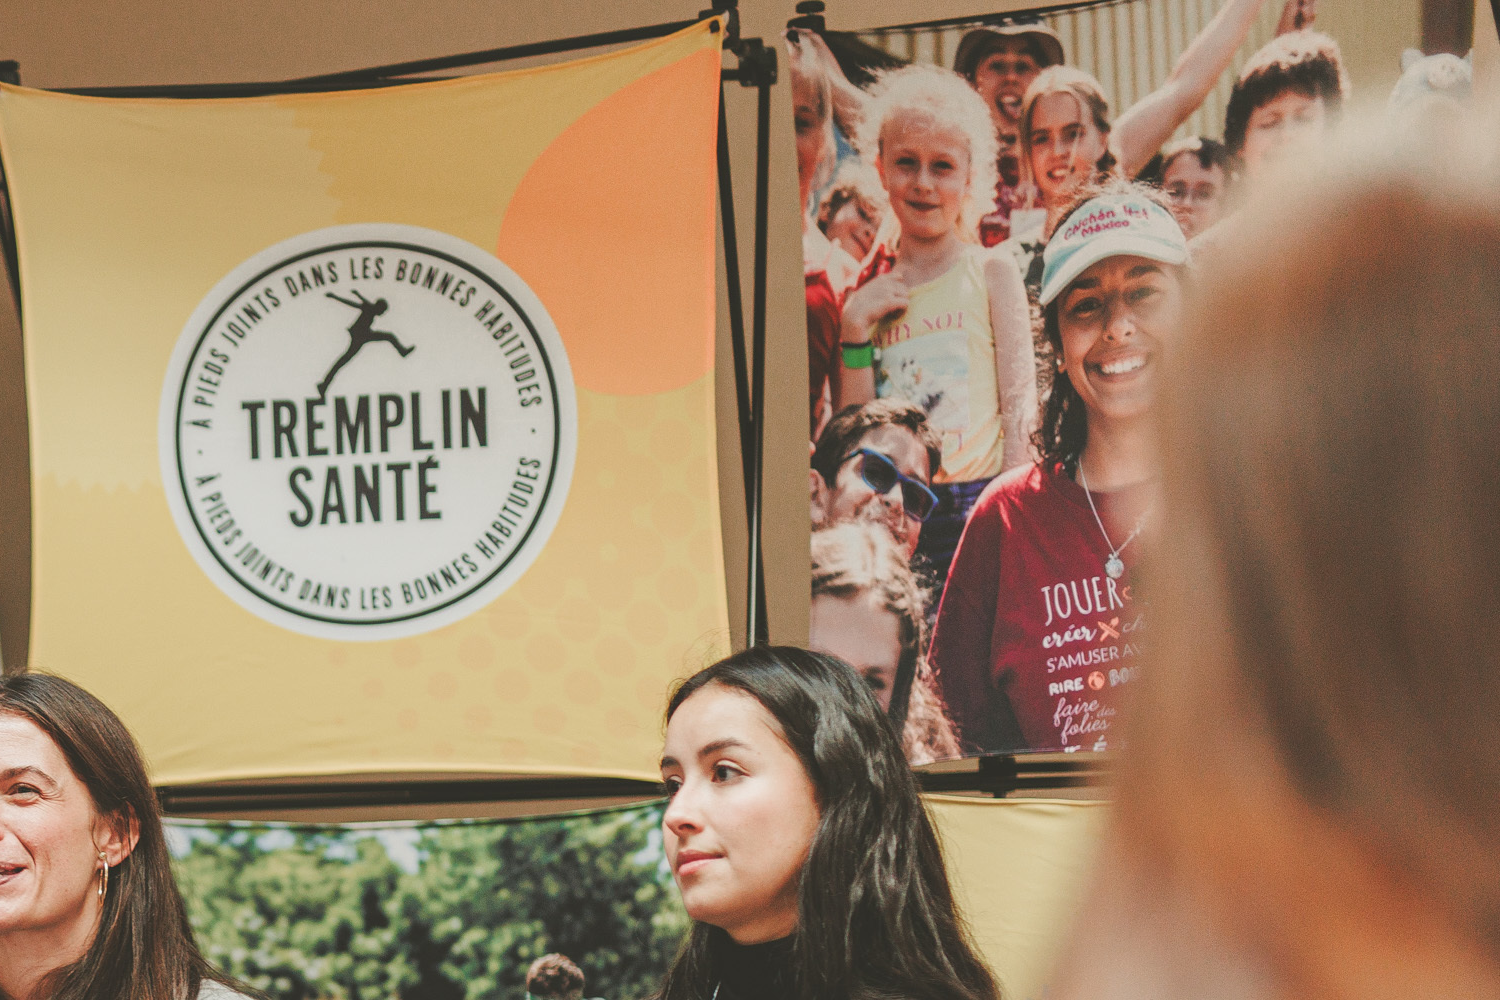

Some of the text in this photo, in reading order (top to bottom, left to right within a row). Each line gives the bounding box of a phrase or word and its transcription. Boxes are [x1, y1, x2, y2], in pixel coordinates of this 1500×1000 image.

[186, 256, 543, 430] À PIEDS JOINTS DANS LES BONNES HABITUDES
[241, 386, 489, 460] TREMPLIN
[288, 455, 442, 528] SANTÉ
[194, 455, 542, 611] À PIEDS JOINTS DANS LES BONNES HABITUDES
[1041, 576, 1125, 627] JOUER
[1042, 623, 1099, 649] créer
[1046, 645, 1120, 674] S'AMUSER
[1048, 676, 1085, 697] RIRE
[1053, 697, 1100, 727] faire
[1060, 712, 1111, 745] folies
